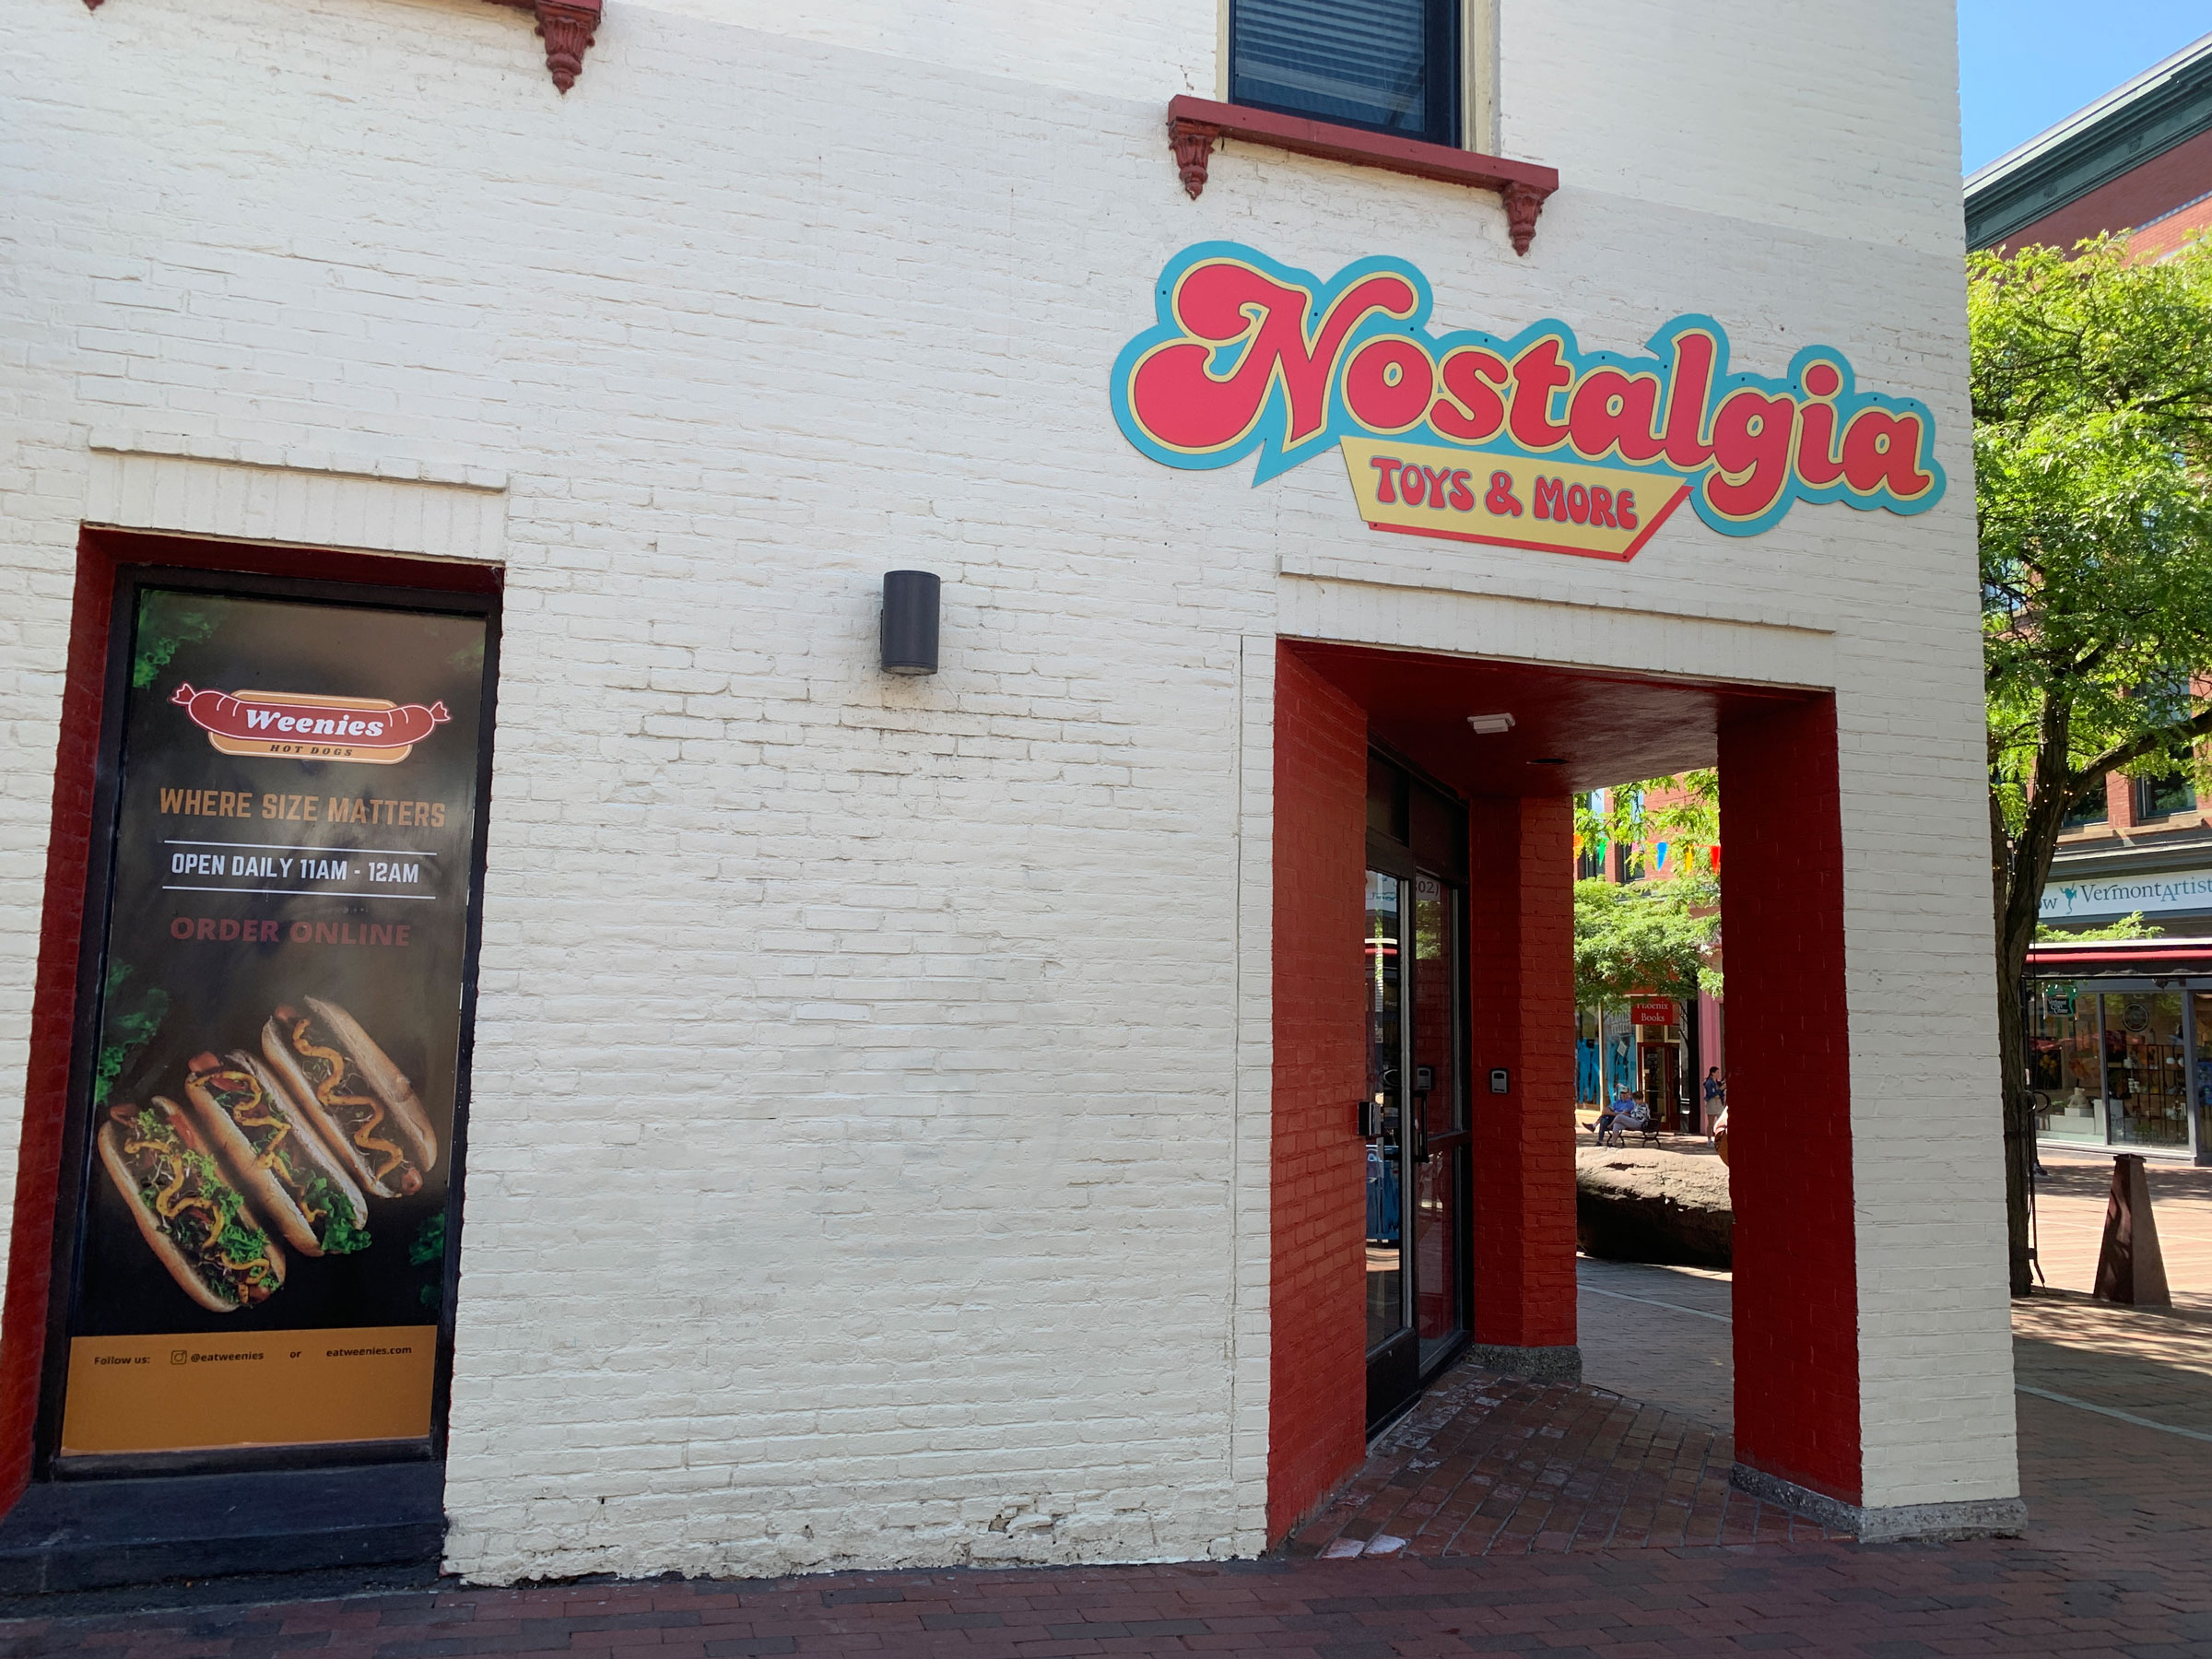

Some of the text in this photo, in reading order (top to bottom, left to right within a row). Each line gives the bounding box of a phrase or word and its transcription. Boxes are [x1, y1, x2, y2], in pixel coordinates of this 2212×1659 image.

[1132, 263, 1932, 516] Nostalgia
[1370, 455, 1641, 534] TOYS & MORE
[245, 709, 384, 737] Weenies
[269, 744, 354, 757] HOT DOGS
[159, 787, 446, 828] WHERE SIZE MATTERS
[171, 853, 226, 877] OPEN
[231, 855, 294, 878] DAILY
[300, 858, 347, 881] 11AM
[368, 861, 420, 884] 12AM
[1416, 880, 1439, 897] 02)
[170, 916, 412, 947] ORDER ONLINE
[1641, 1013, 1665, 1022] Books
[94, 1357, 131, 1365] Follow
[191, 1351, 265, 1362] @eatweenies
[289, 1350, 301, 1359] or
[325, 1346, 412, 1357] eatweenies.com
